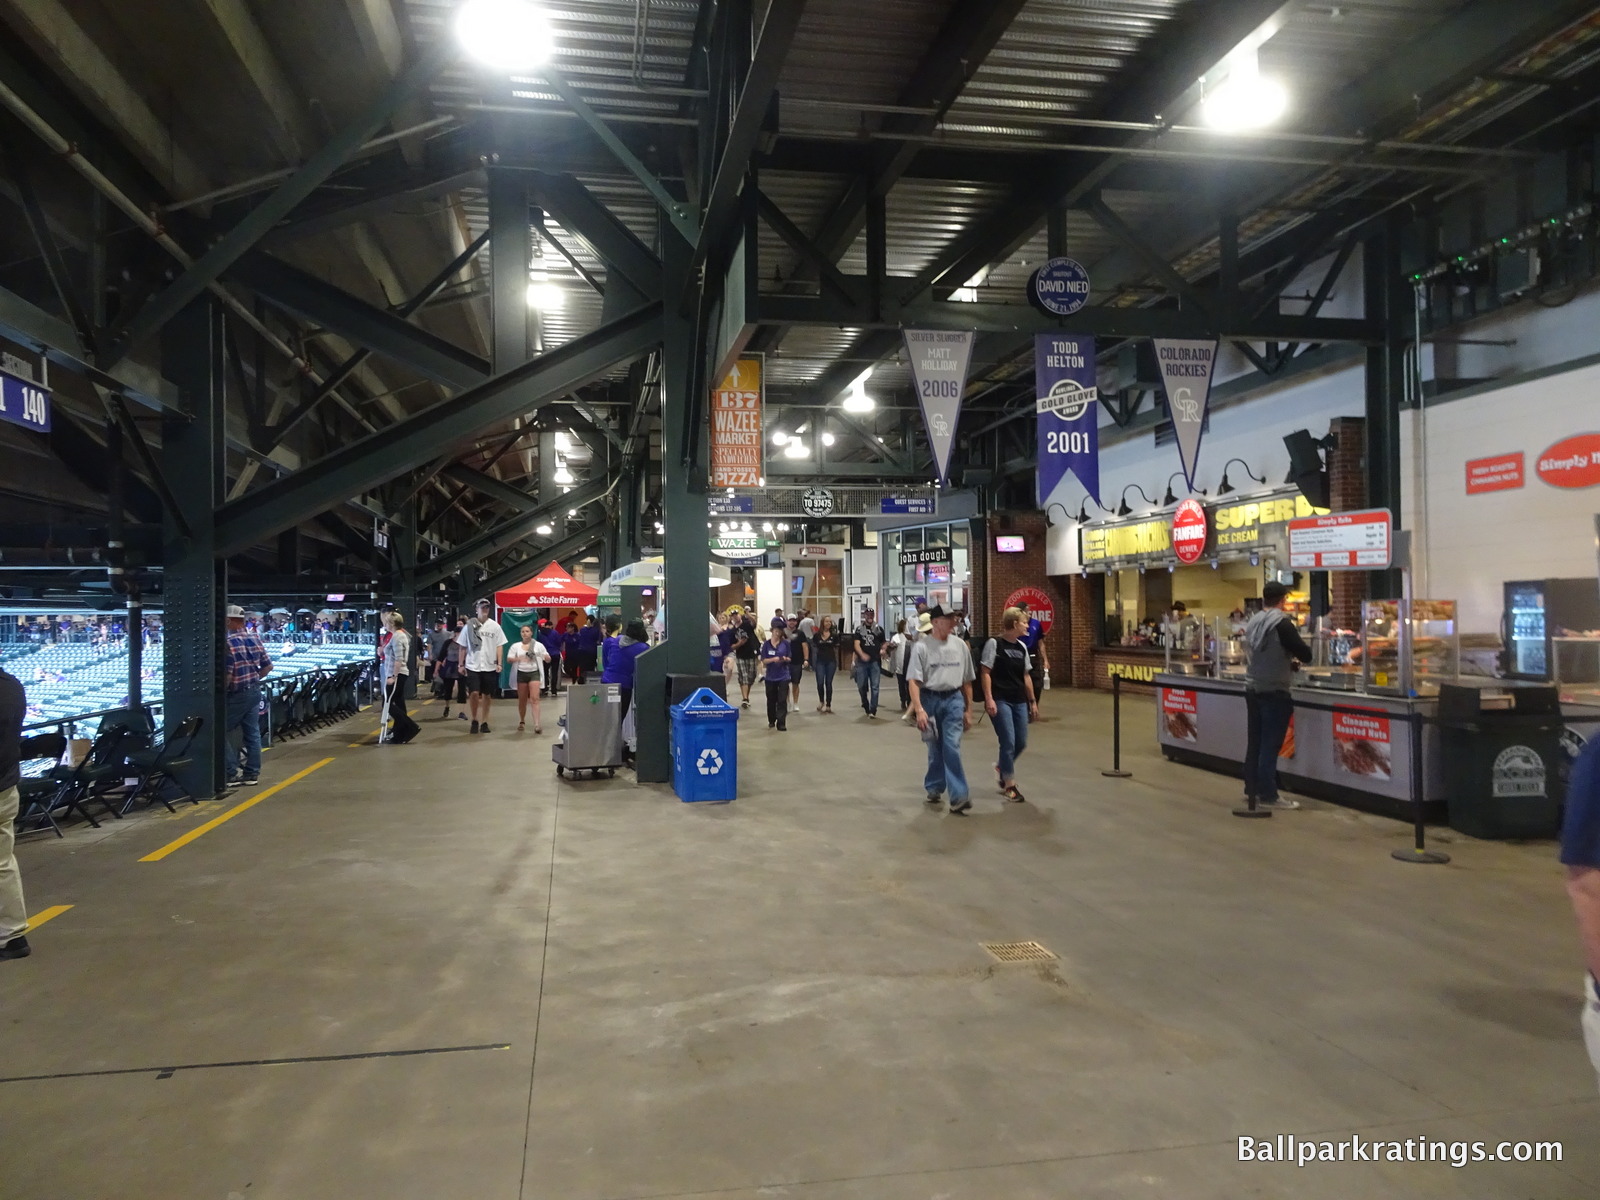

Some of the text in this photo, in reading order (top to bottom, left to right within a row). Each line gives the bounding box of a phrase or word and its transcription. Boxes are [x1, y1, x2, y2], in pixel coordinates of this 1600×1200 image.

[1039, 280, 1088, 293] DAVID NIED
[911, 332, 967, 343] SILVER SLUGGER
[928, 348, 951, 359] MATT
[1052, 341, 1078, 354] TODD
[1160, 347, 1211, 361] COLORADO
[921, 360, 958, 371] HOLLIDAY
[1047, 355, 1085, 368] HELTON
[1166, 364, 1207, 377] ROCKIES
[922, 380, 958, 398] 2006
[22, 386, 46, 425] 140
[720, 391, 759, 409] 137
[1041, 390, 1094, 410] GOLD GLOVE
[1062, 405, 1079, 415] AWARD
[714, 410, 758, 432] WAZEE
[715, 432, 758, 445] MARKET
[1047, 431, 1090, 454] 2001
[715, 447, 757, 456] SPECIALTY
[1539, 454, 1588, 471] Simply
[714, 472, 758, 486] PIZZA
[814, 499, 832, 507] 97475
[1215, 498, 1295, 531] SUPER
[1173, 524, 1205, 542] FANFARE
[1217, 529, 1258, 545] ICE CREAM
[717, 539, 757, 548] WAZEE
[900, 548, 947, 565] john dough
[1008, 589, 1049, 606] COORS FIELD
[1342, 715, 1380, 729] Cinnamon
[1335, 723, 1388, 740] Roasted Nuts
